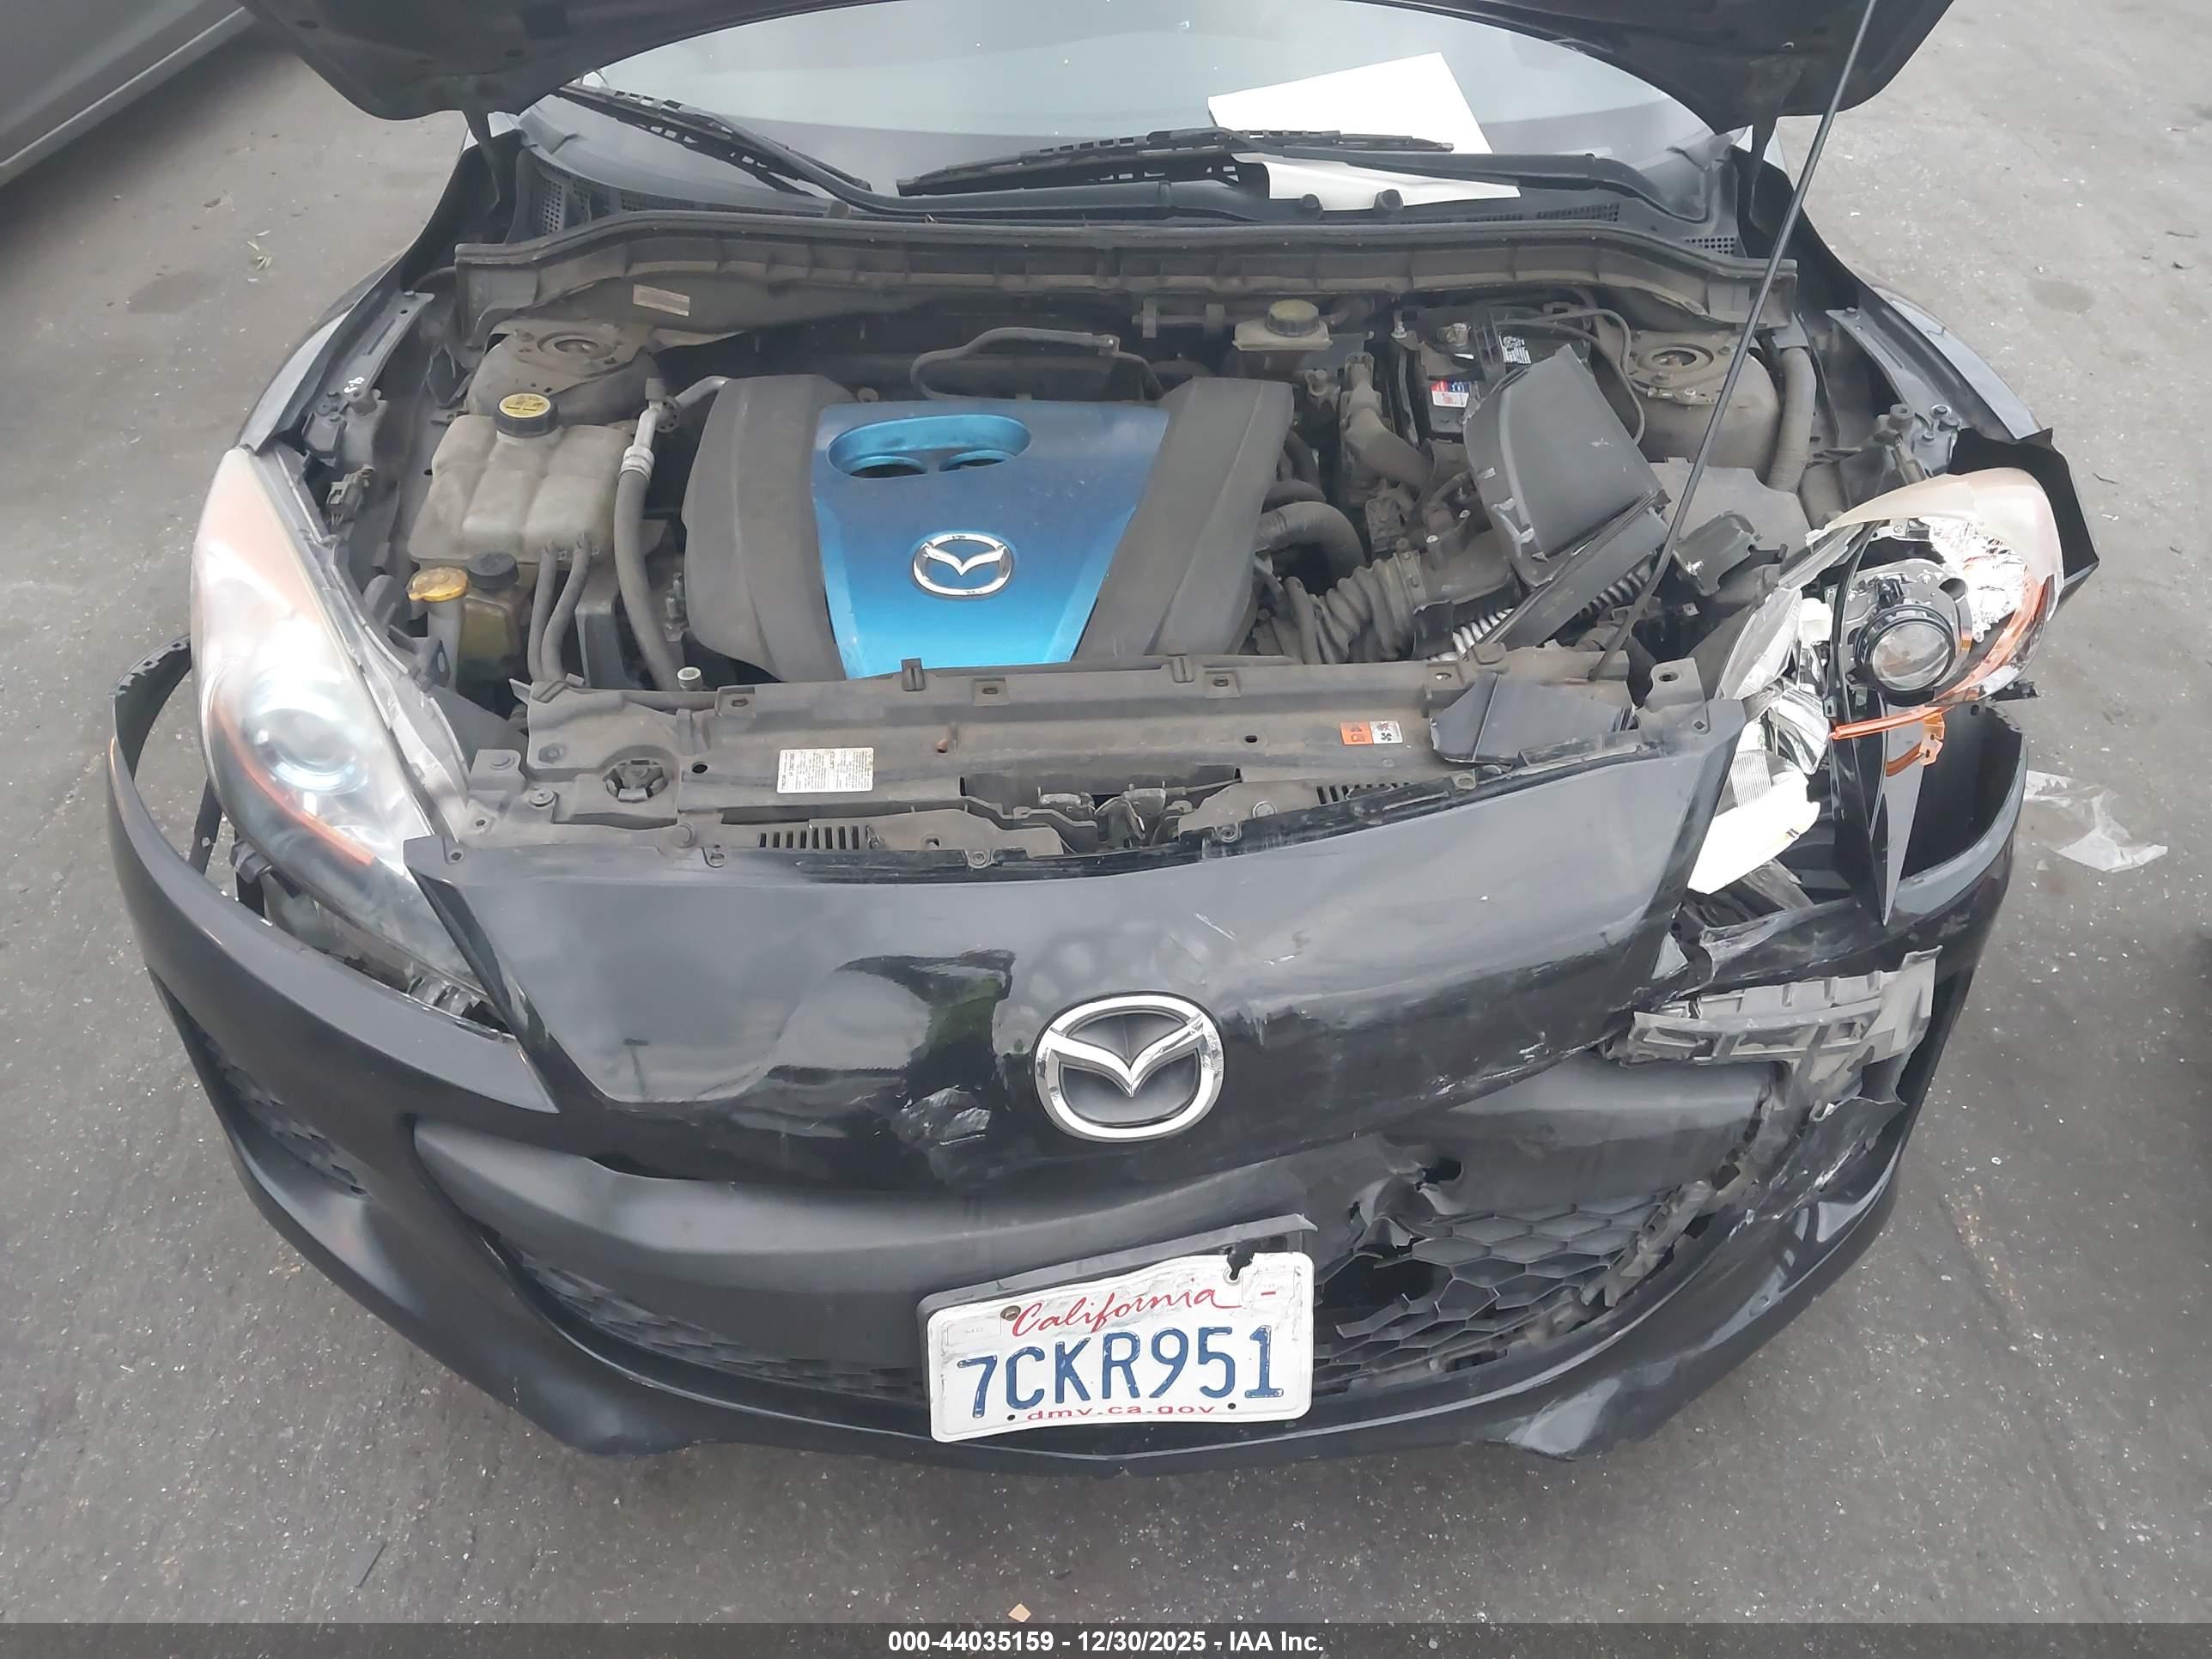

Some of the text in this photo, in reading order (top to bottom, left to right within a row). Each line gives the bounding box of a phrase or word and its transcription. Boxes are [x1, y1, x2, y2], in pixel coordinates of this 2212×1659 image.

[1012, 1277, 1242, 1336] California
[957, 1325, 1285, 1419] 7CKR951
[1027, 1405, 1216, 1422] dmv.ca.gov
